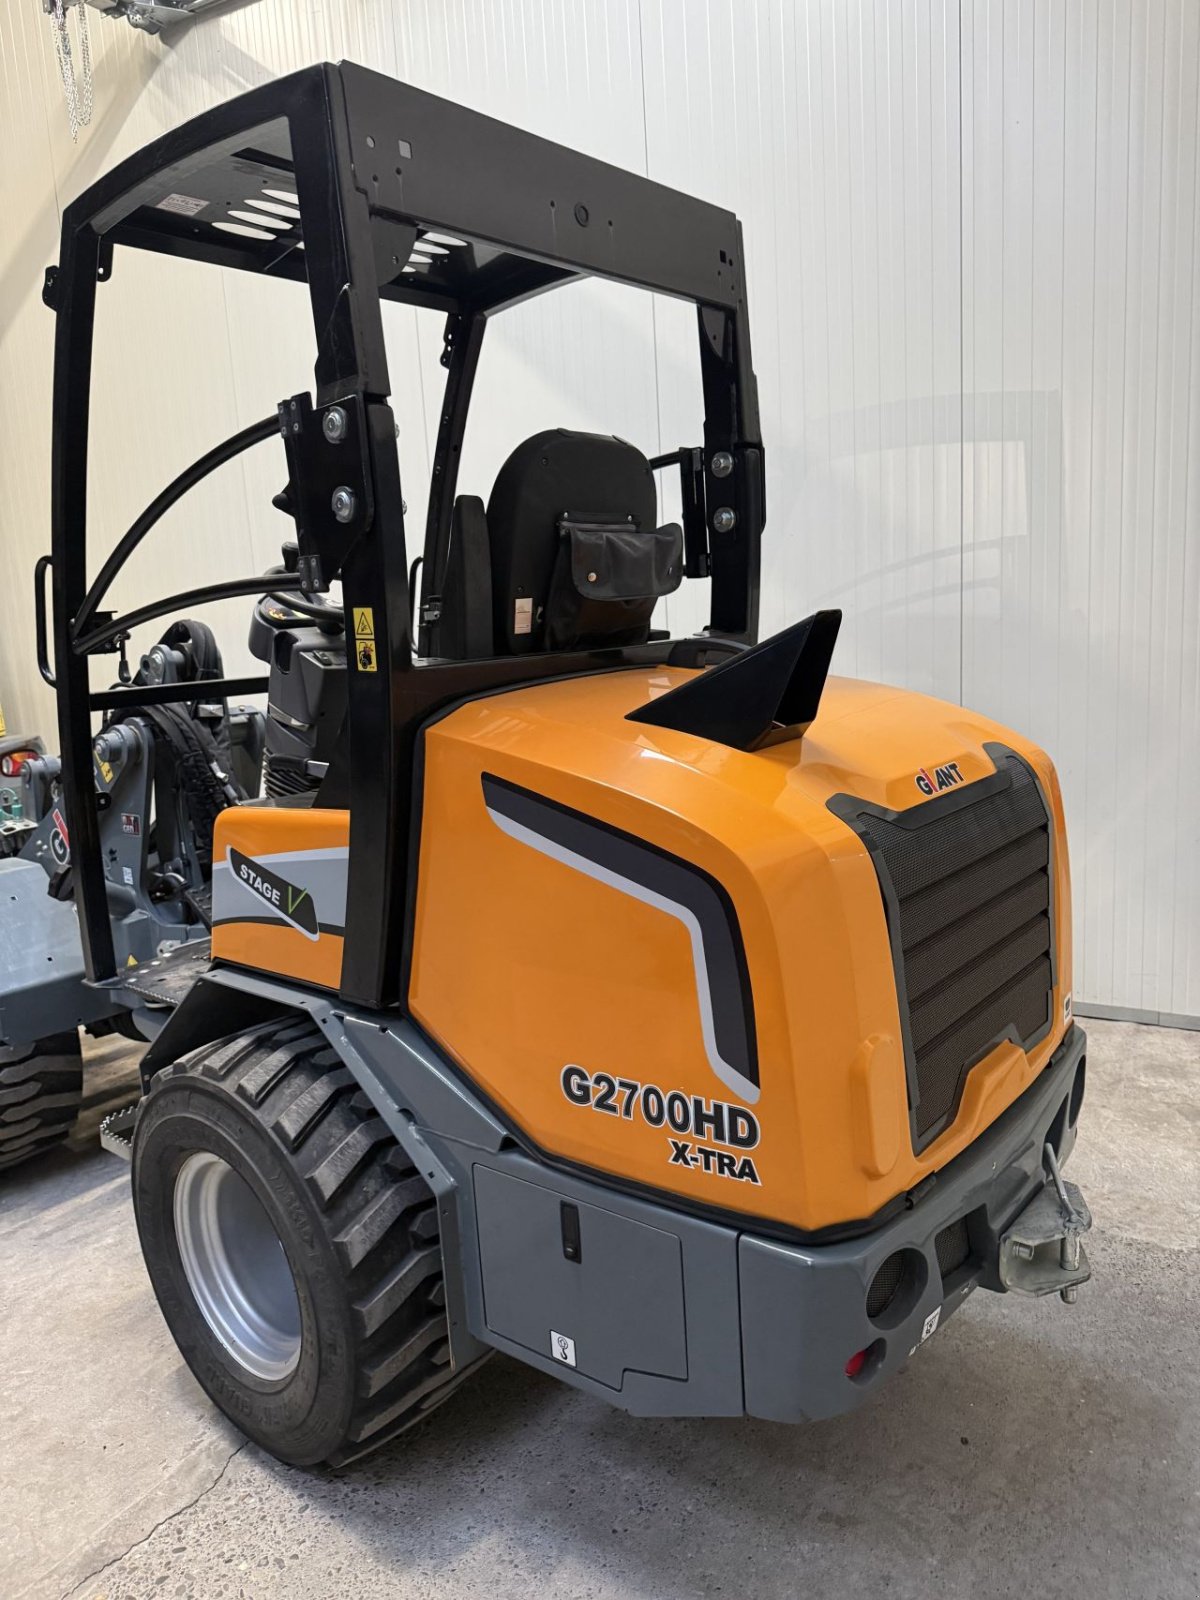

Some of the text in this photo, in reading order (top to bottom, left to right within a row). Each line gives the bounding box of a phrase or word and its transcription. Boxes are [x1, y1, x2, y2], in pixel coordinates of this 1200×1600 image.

[240, 864, 307, 914] STAGE V
[560, 1064, 761, 1150] G2700HD
[668, 1138, 762, 1186] X-TRA
